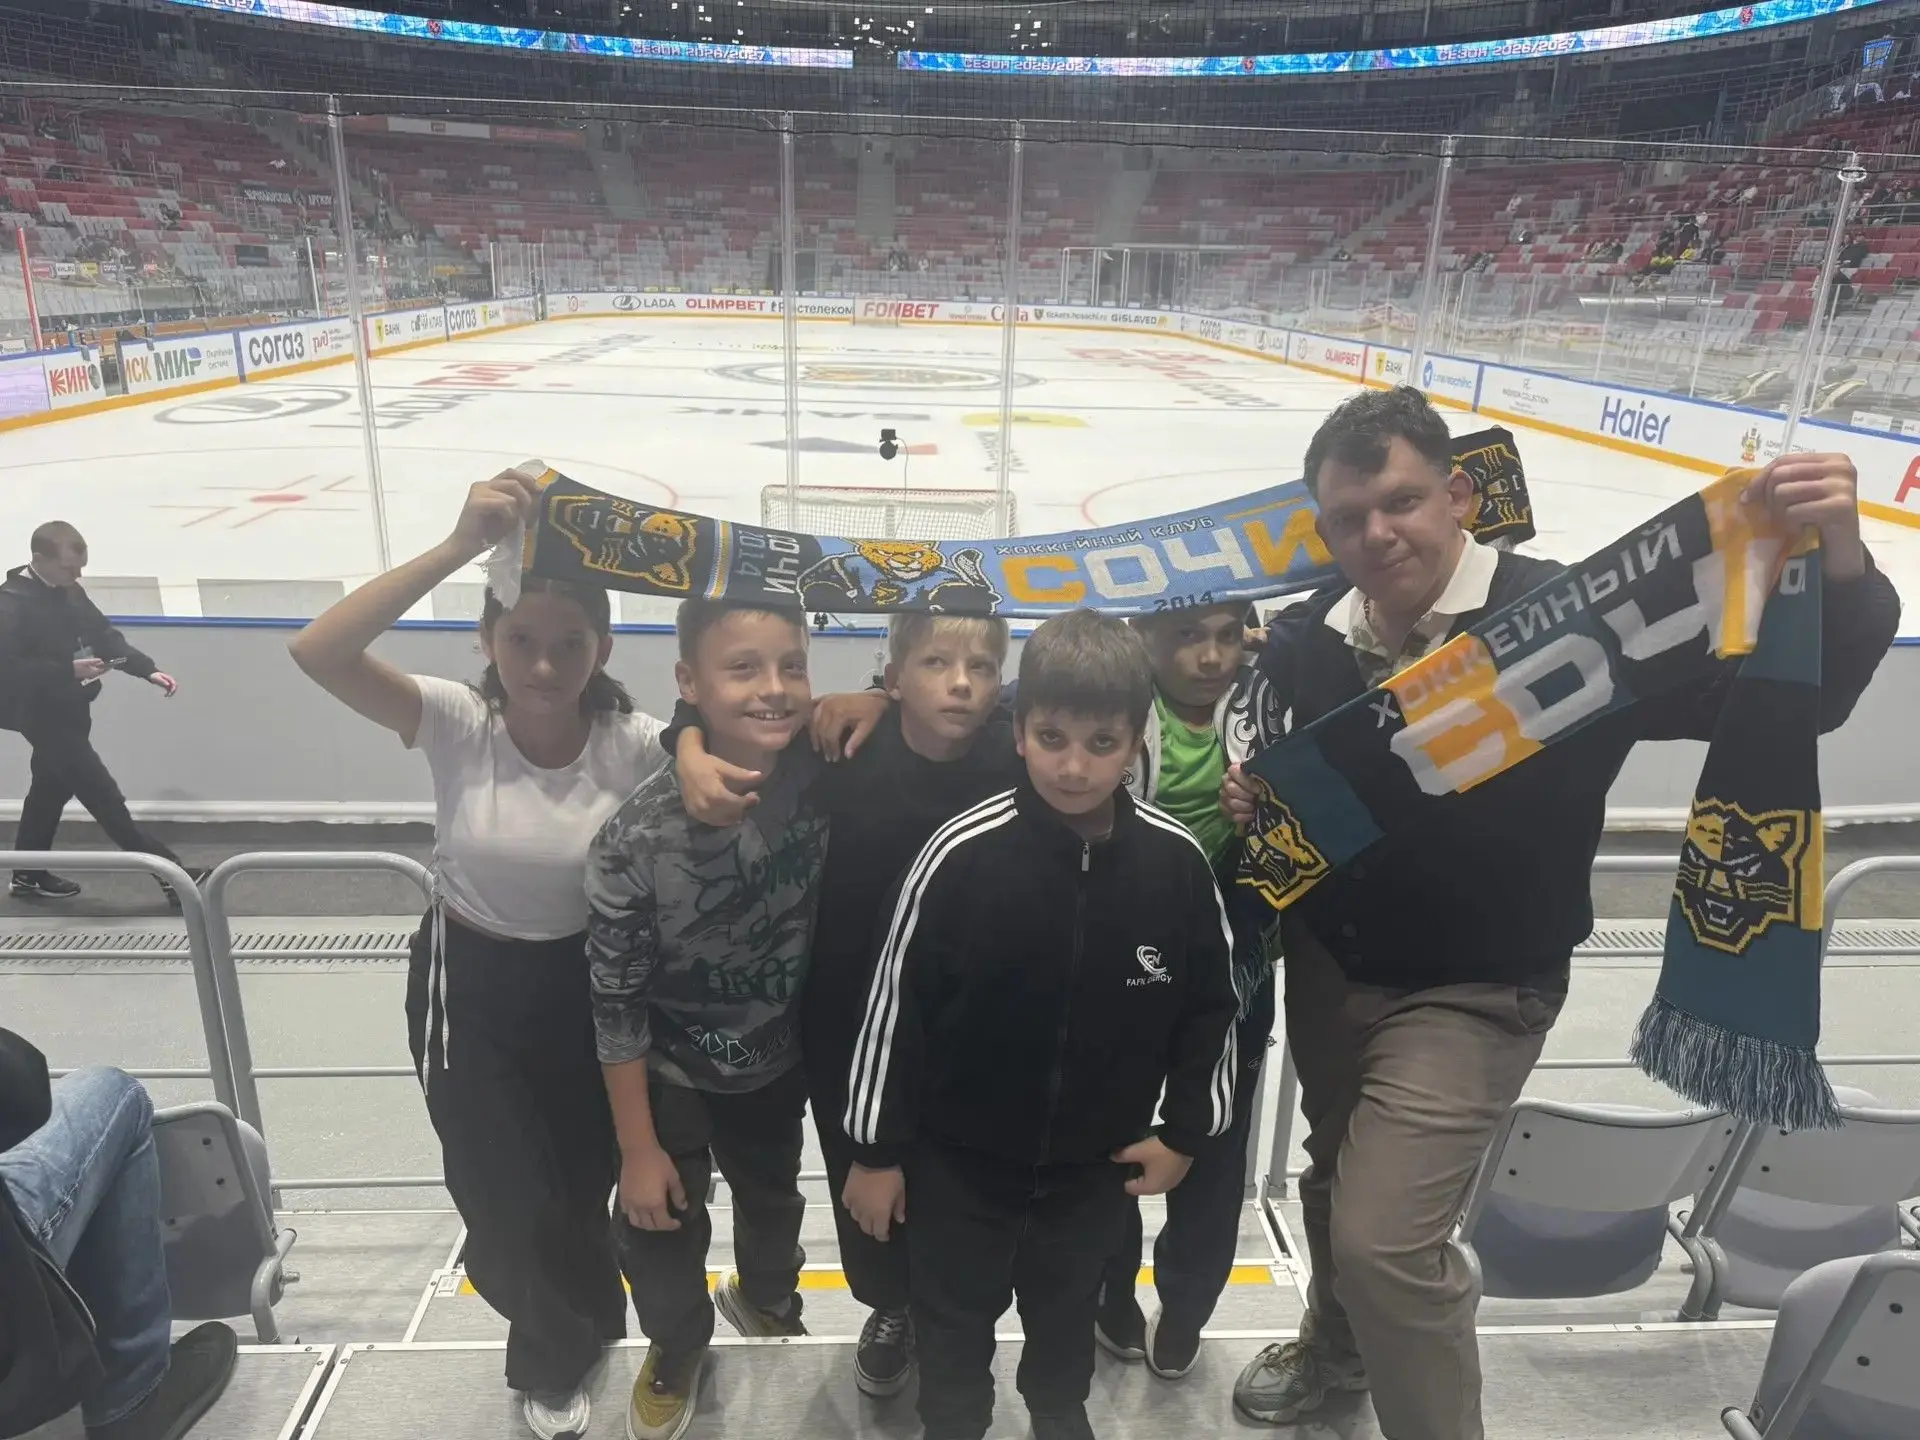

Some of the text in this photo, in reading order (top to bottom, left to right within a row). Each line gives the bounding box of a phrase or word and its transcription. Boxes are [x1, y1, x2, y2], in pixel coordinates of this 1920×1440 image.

[1440, 47, 1488, 60] СЕЗОН
[964, 57, 1010, 70] СЕЗОН
[643, 298, 676, 309] LADA
[685, 298, 766, 312] OLIMPBET
[778, 301, 853, 315] Рстелеком
[863, 302, 939, 319] FONBET
[1111, 313, 1157, 325] GISLAVED
[153, 346, 202, 382] МИР
[1325, 348, 1362, 368] OLIMPBET
[1599, 395, 1672, 446] Haier
[995, 515, 1216, 556] ХОККЕЙНЫЙ КЛУБ
[1002, 507, 1335, 605] СОЧИ
[1153, 590, 1215, 614] 2014
